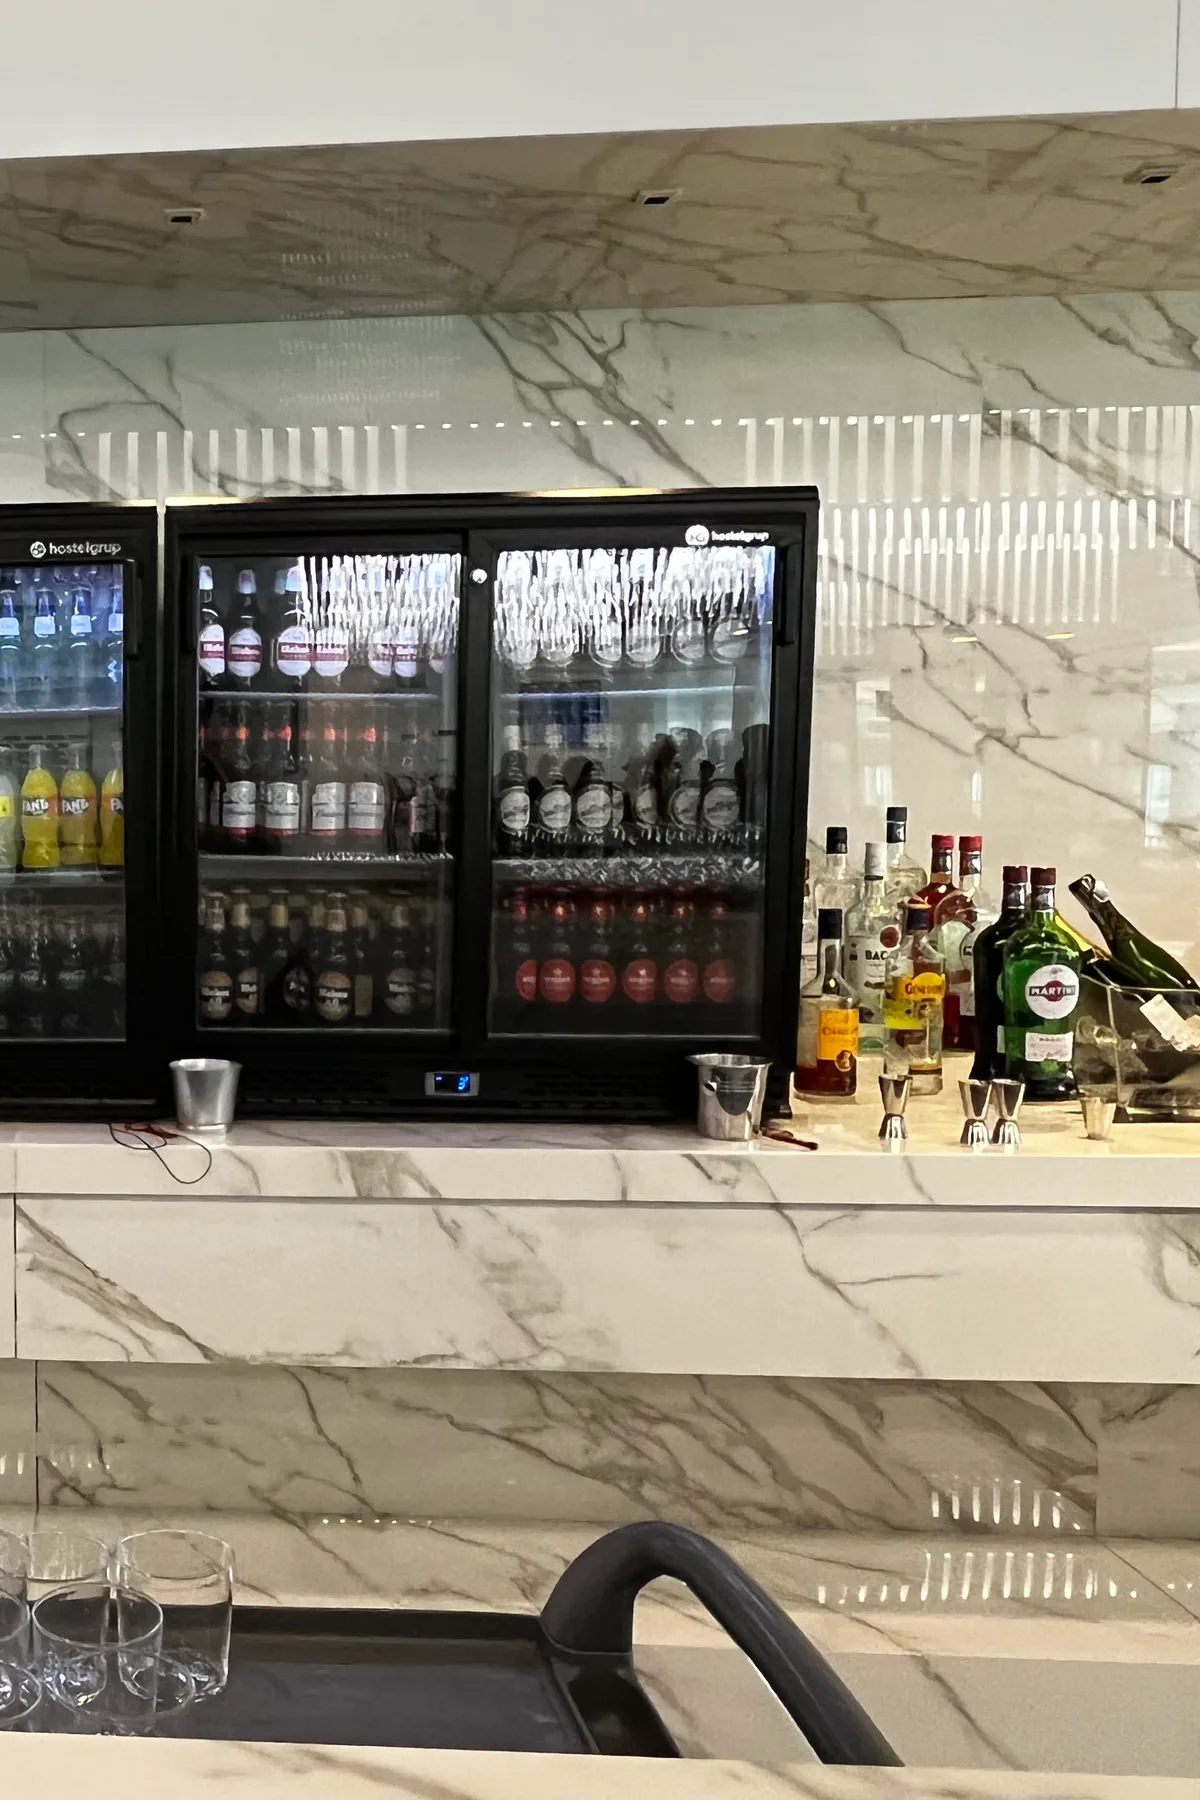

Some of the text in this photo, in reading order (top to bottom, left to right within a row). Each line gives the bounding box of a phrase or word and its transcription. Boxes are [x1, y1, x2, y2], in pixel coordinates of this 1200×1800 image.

[49, 541, 121, 556] hostelgrup
[1030, 986, 1076, 995] MARTINI
[457, 1076, 469, 1090] 3
